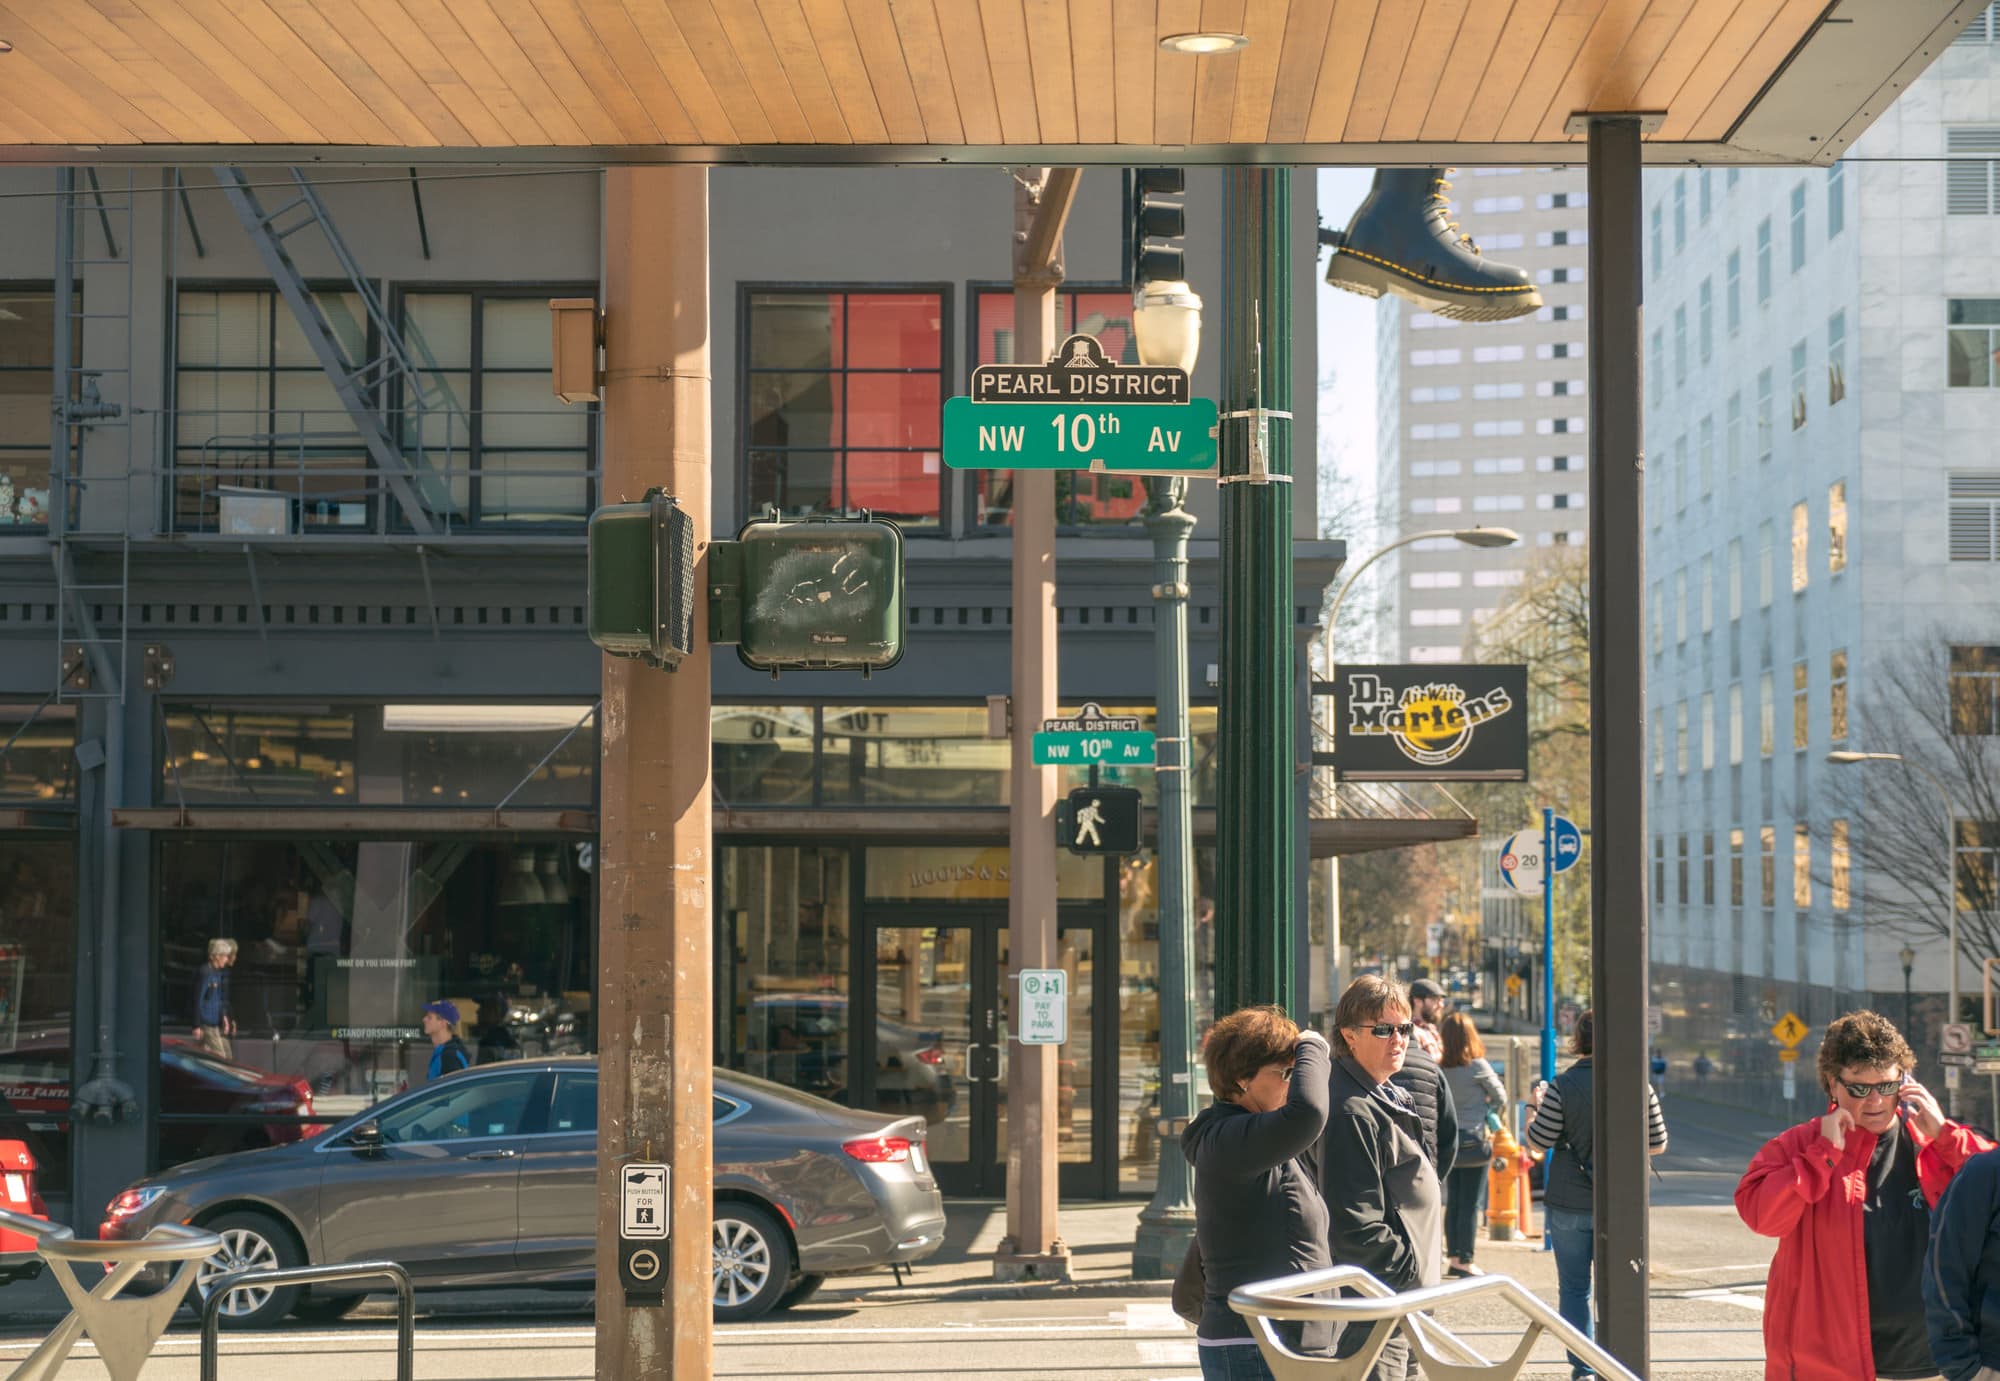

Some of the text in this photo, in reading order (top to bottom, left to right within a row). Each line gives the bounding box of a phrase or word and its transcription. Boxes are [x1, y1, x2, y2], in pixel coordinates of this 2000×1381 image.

[980, 374, 1181, 395] PEARL DISTRICT
[978, 425, 1025, 452] NW
[1051, 412, 1121, 453] 10th
[1349, 674, 1394, 705] Dr.
[1398, 682, 1466, 709] AirWair
[1349, 687, 1512, 735] Martens
[1045, 720, 1137, 732] PEARL DISTRICT
[1047, 745, 1070, 758] NW
[1079, 738, 1113, 758] 10th
[1521, 854, 1538, 866] 20
[1033, 1001, 1051, 1010] PAY
[1037, 1010, 1049, 1020] TO
[1030, 1020, 1055, 1029] PARK
[636, 1198, 653, 1206] FOR
